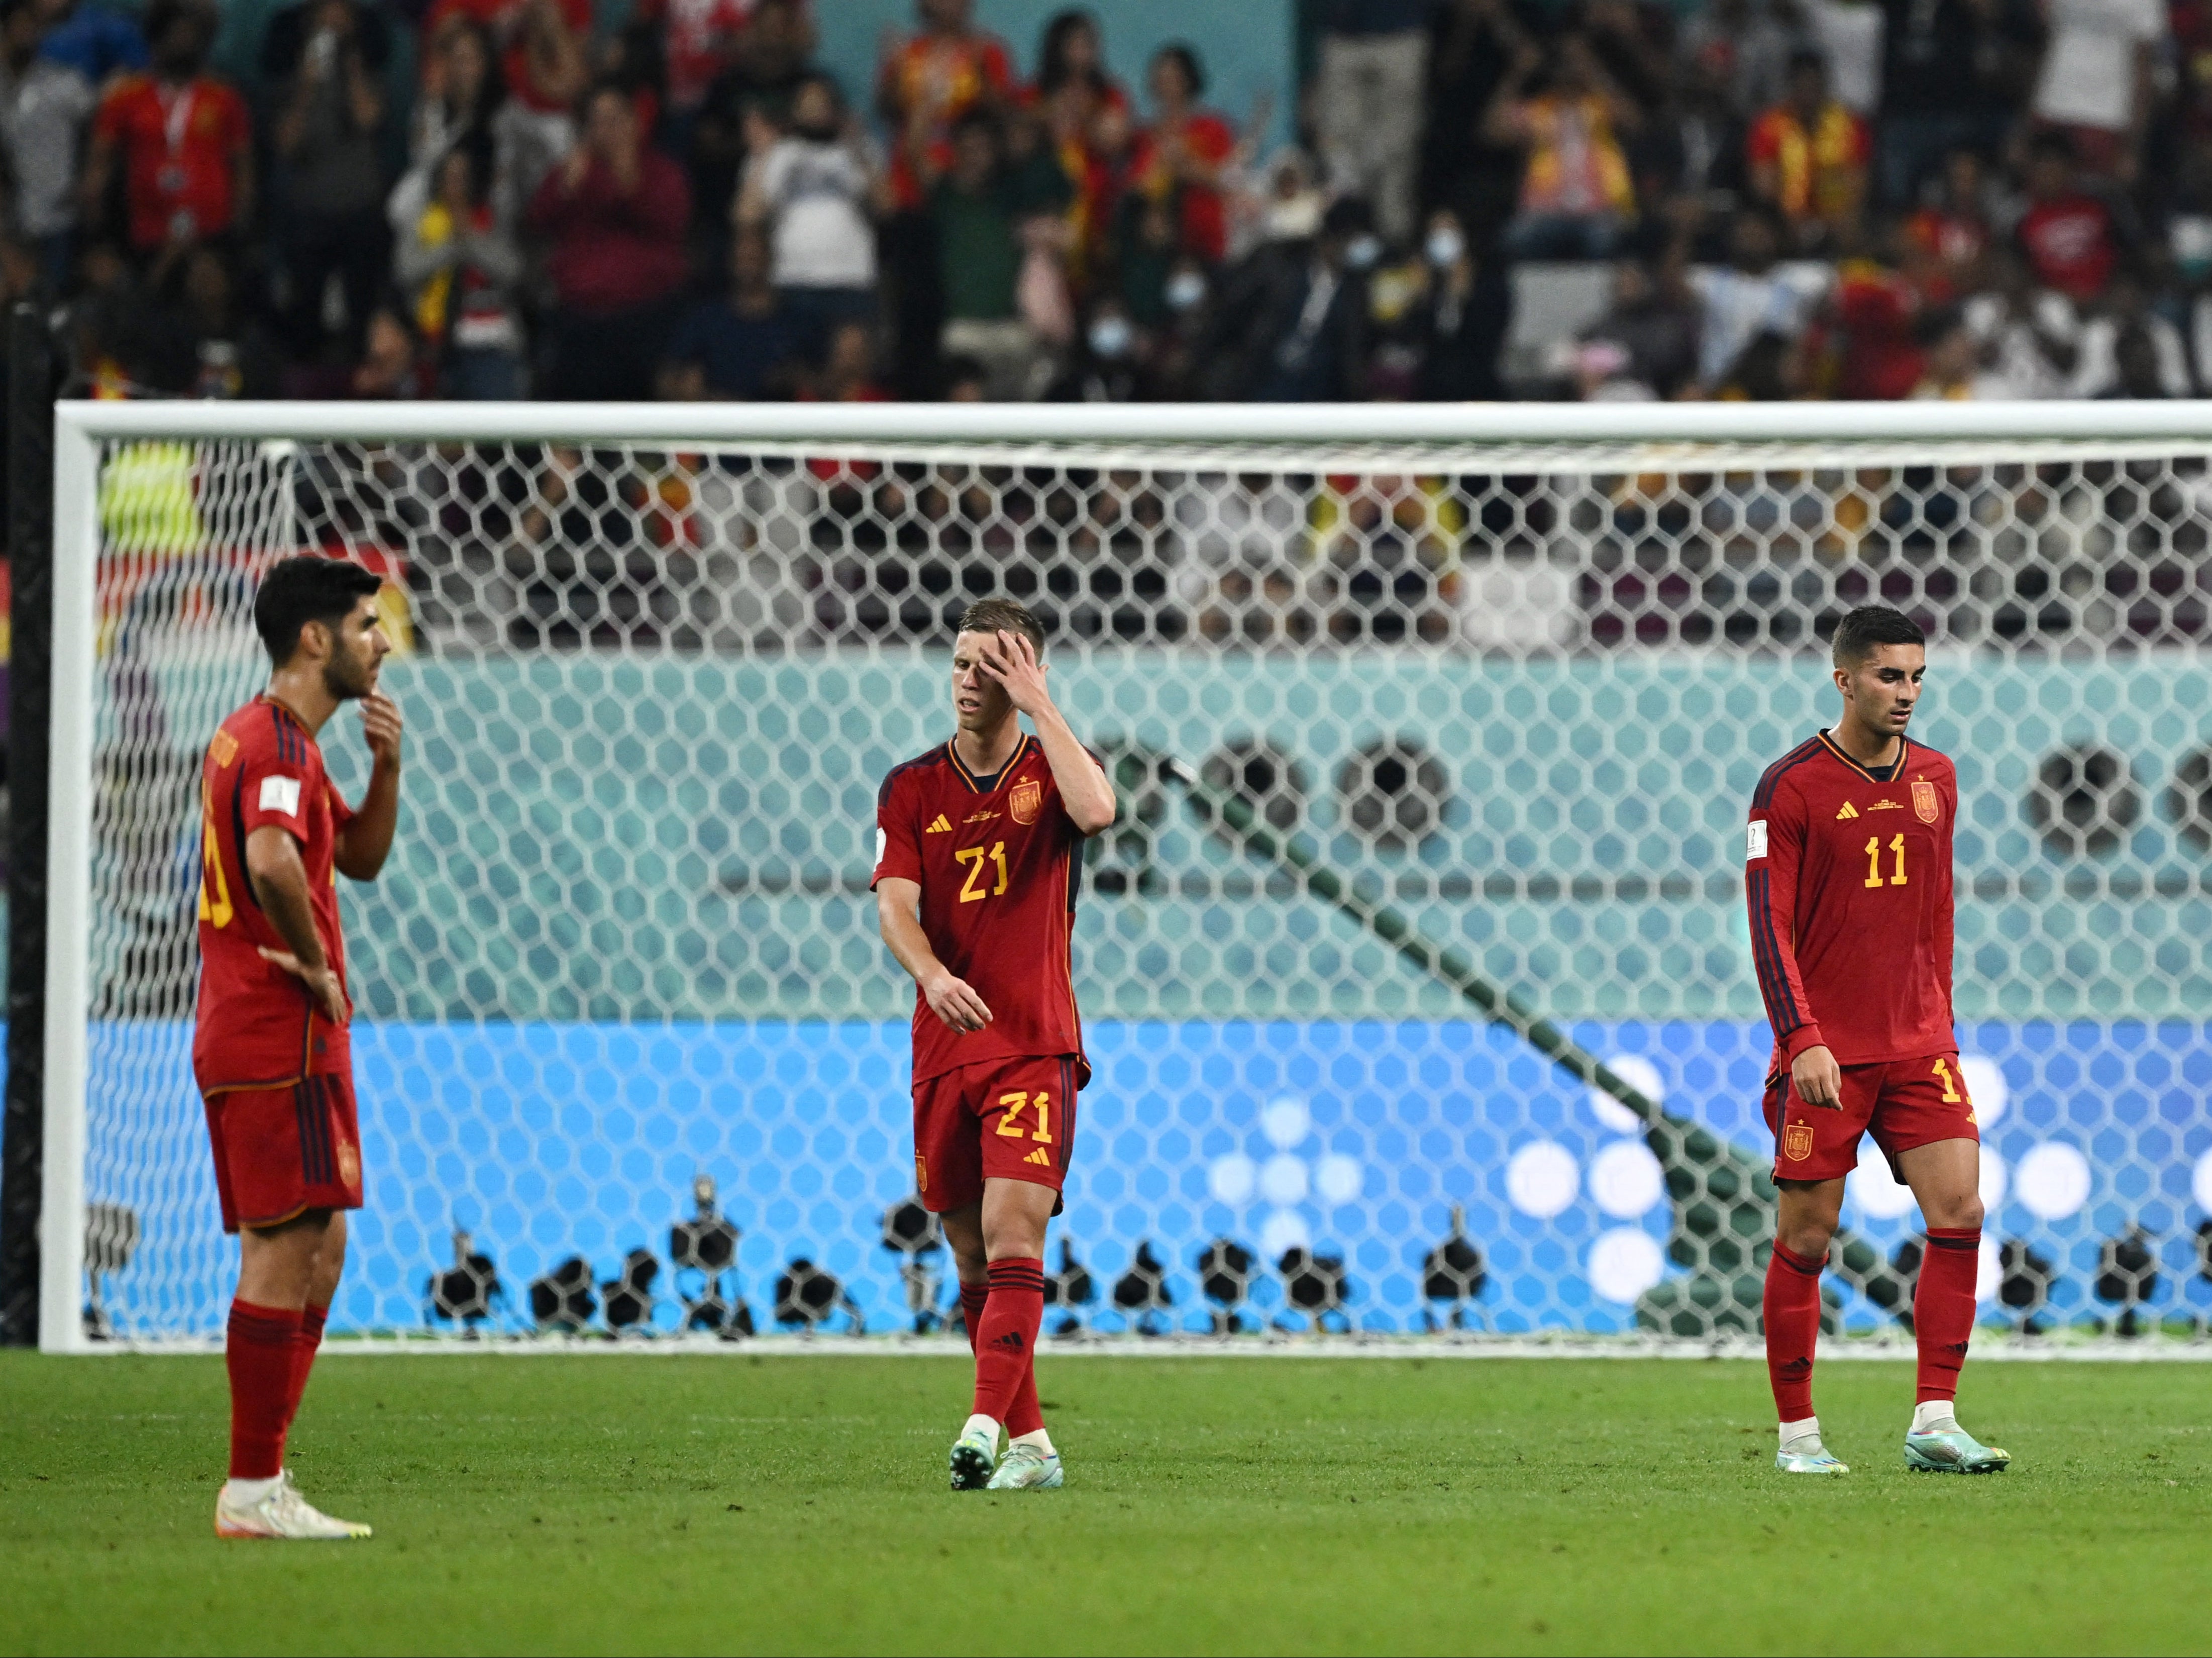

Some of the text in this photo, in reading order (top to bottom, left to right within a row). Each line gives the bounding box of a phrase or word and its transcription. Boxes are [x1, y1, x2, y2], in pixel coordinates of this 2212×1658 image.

[955, 841, 1008, 903] 21
[1865, 834, 1908, 888] 11
[1932, 1058, 1972, 1105] 1
[996, 1091, 1052, 1144] 21
